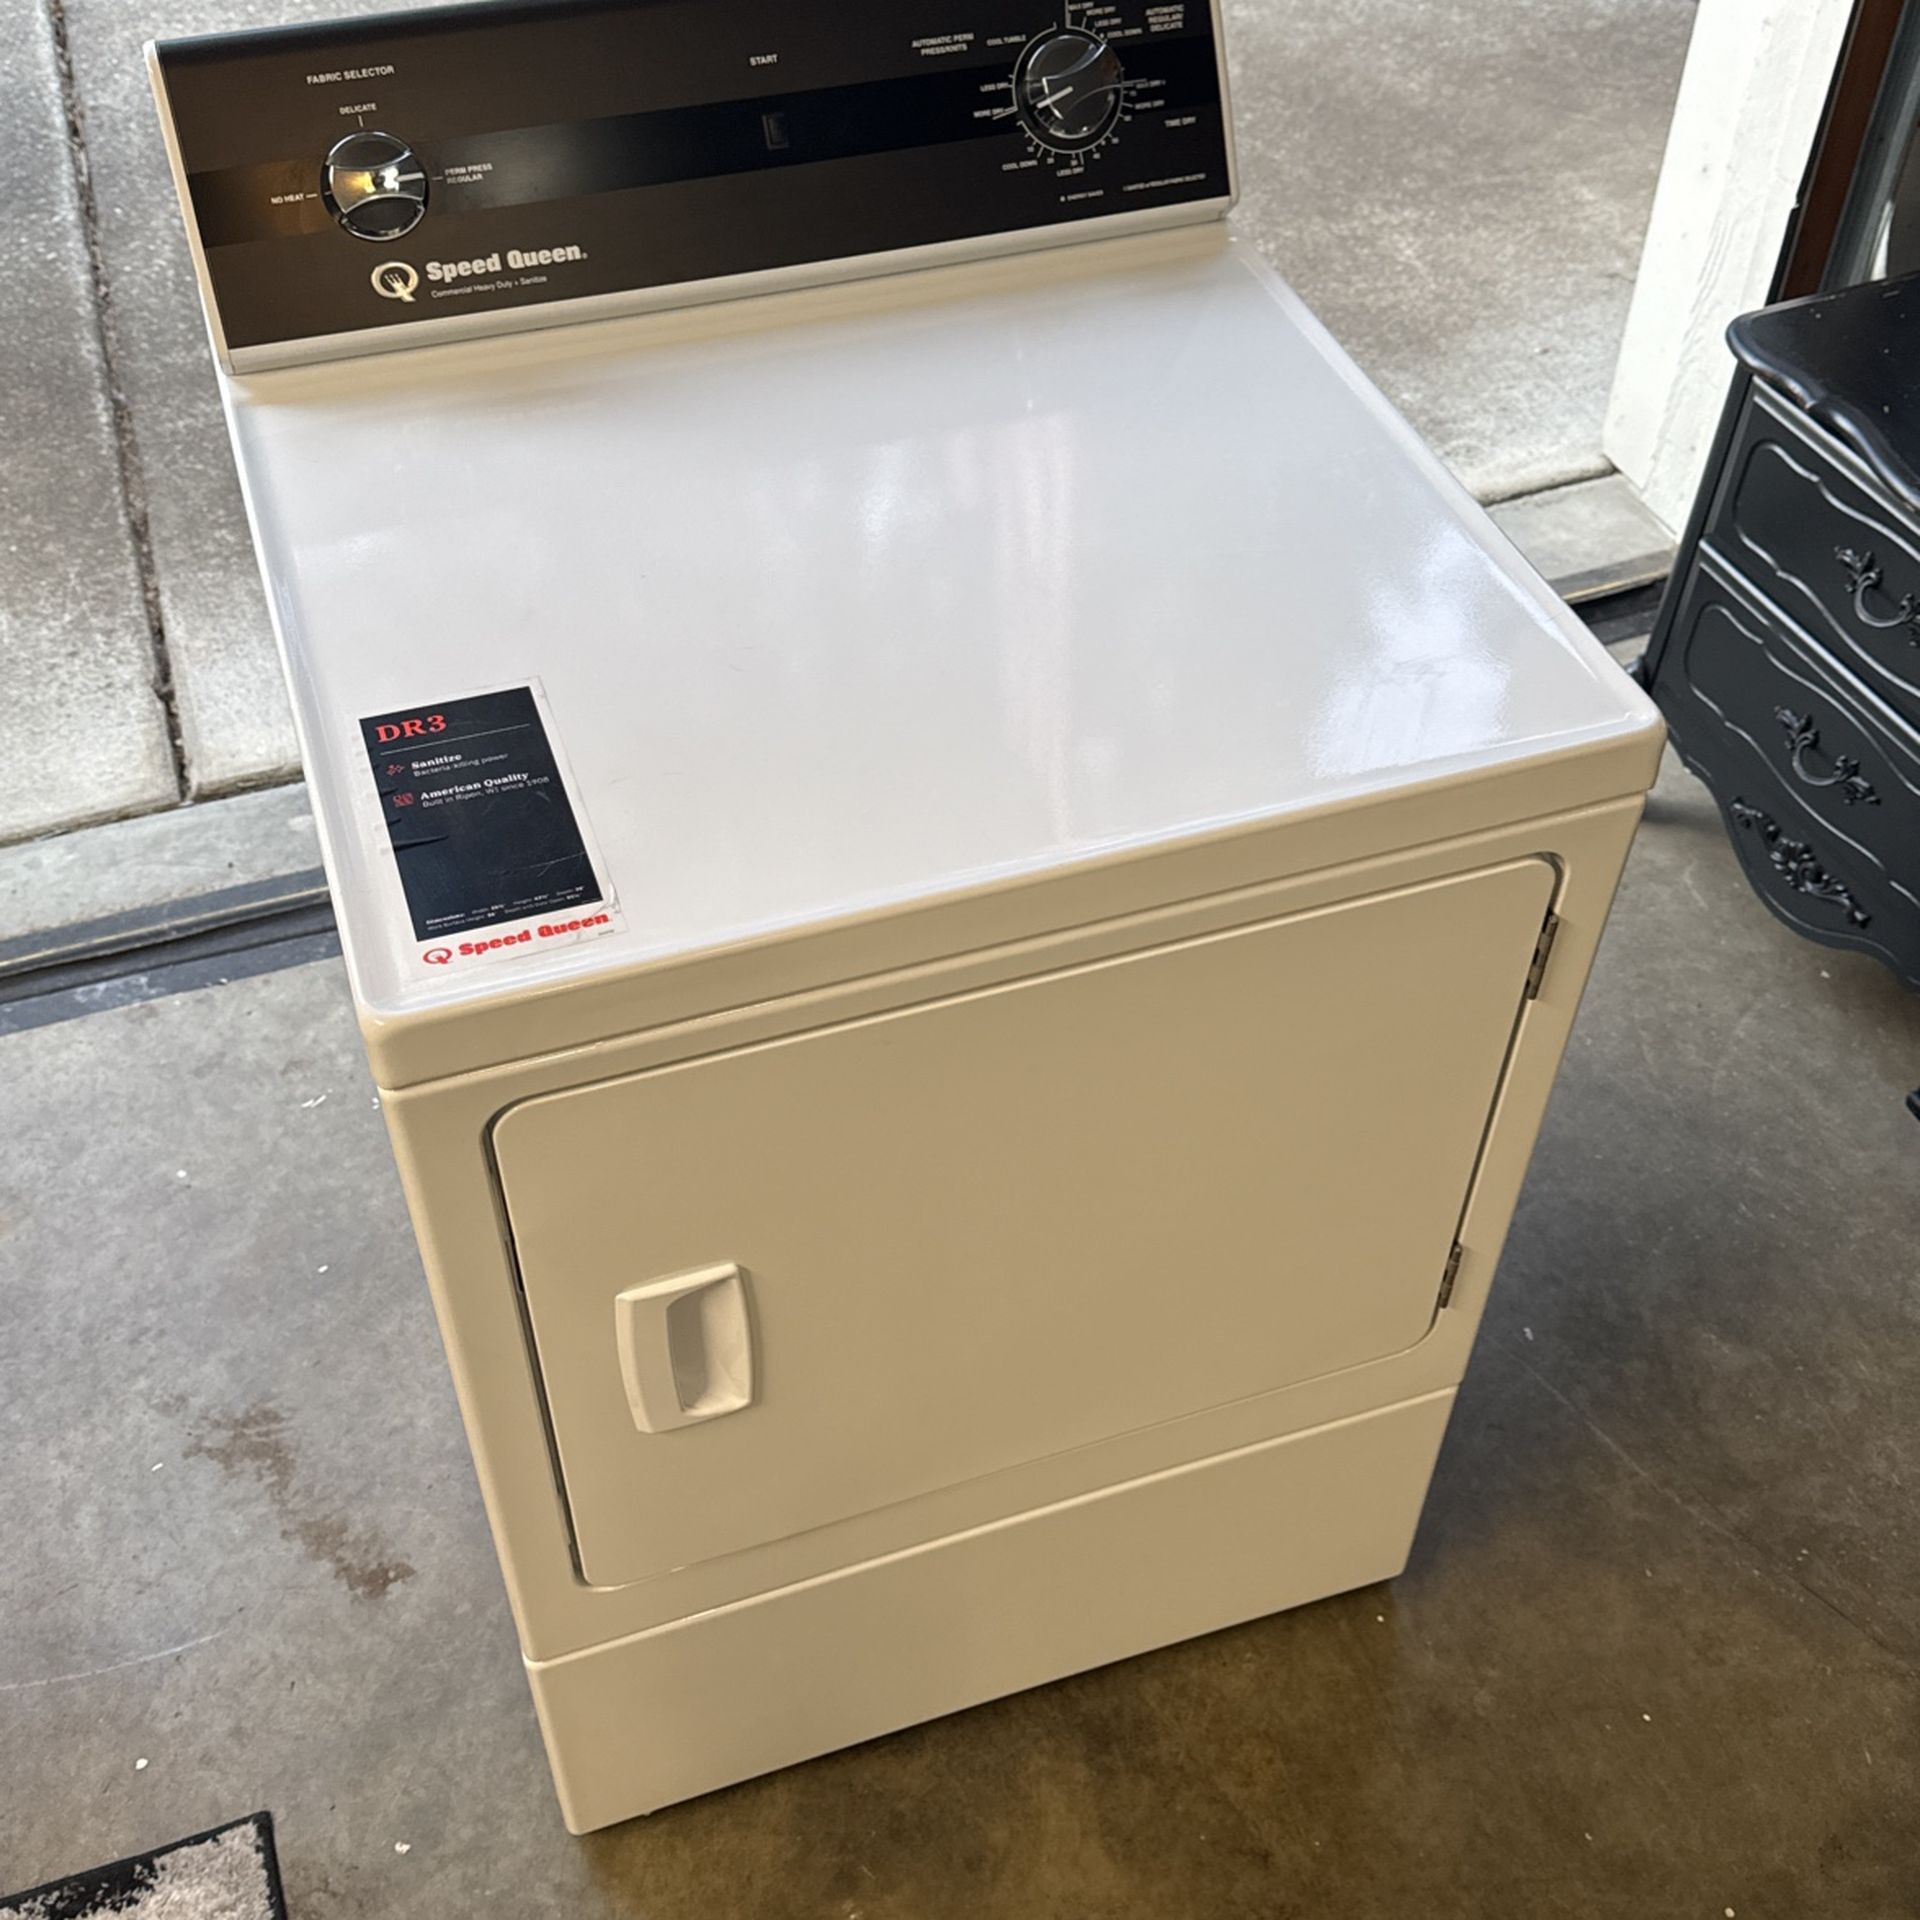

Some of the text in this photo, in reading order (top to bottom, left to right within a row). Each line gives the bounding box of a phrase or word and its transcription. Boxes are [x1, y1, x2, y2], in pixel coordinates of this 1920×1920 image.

[1149, 21, 1184, 32] DELICATE
[911, 32, 975, 48] AUTOMATIC PERM
[749, 53, 778, 66] START
[306, 65, 395, 85] FABRIC SELECTOR
[339, 102, 377, 115] DELICATE
[1164, 116, 1197, 128] TIME DRY
[445, 163, 493, 176] PERM PRESS
[447, 173, 484, 184] REGULAR
[271, 192, 304, 205] NO HEAT
[425, 253, 502, 283] Speed
[431, 275, 548, 299] Commercial Heavy Duty Sanitize
[375, 714, 447, 743] DR3
[411, 753, 462, 770] Sanitize
[480, 753, 508, 766] power
[420, 772, 530, 800] American Quality
[422, 798, 444, 809] Built
[500, 781, 525, 792] since
[458, 914, 610, 956] Speed Queen
